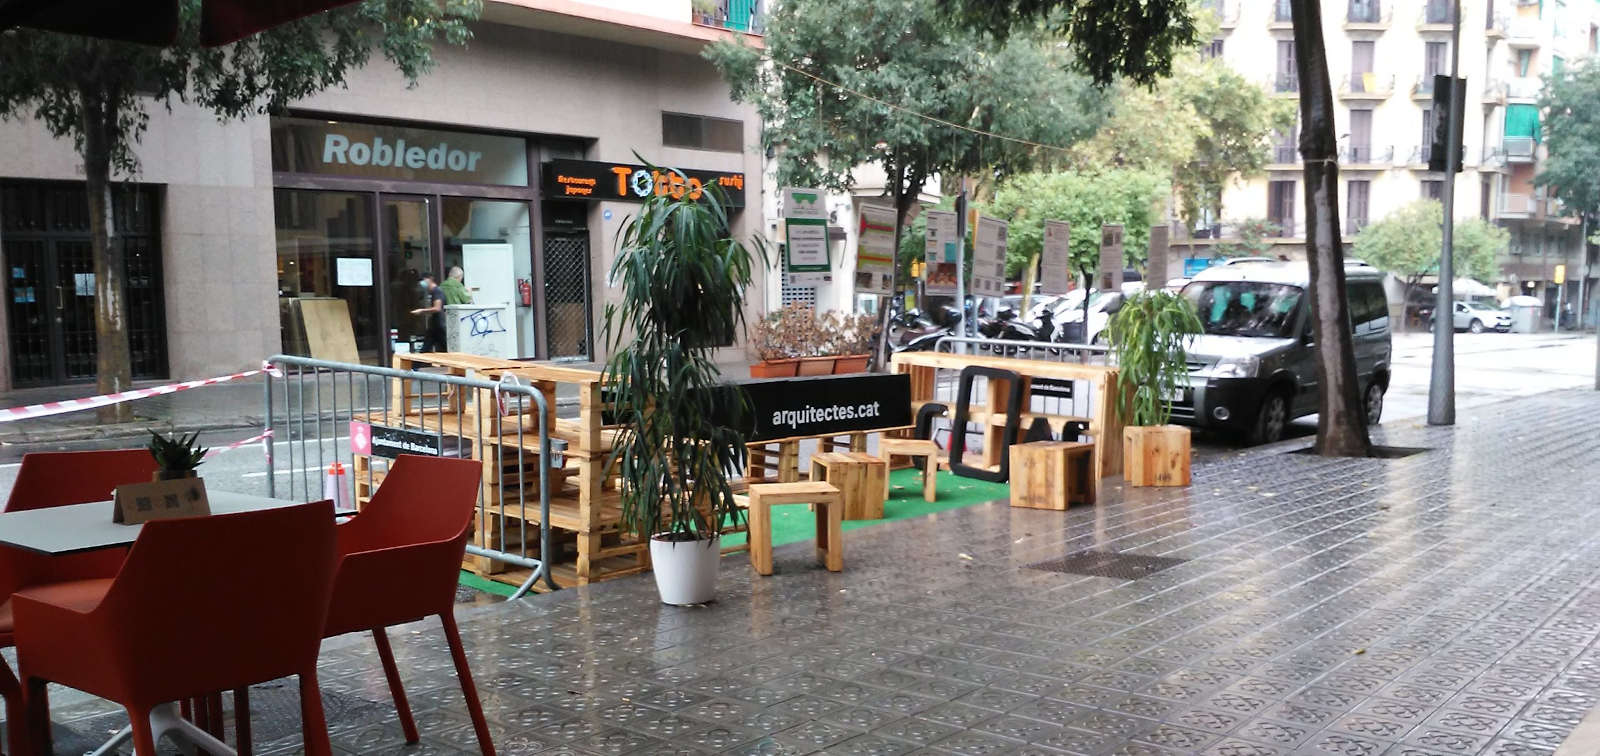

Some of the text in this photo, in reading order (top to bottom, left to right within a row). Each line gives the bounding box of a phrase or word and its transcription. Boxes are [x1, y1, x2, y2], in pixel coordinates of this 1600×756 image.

[322, 133, 482, 172] Robledor
[772, 400, 880, 429] arquitectes.cat
[372, 436, 437, 454] Ajuntament de Barcelona
